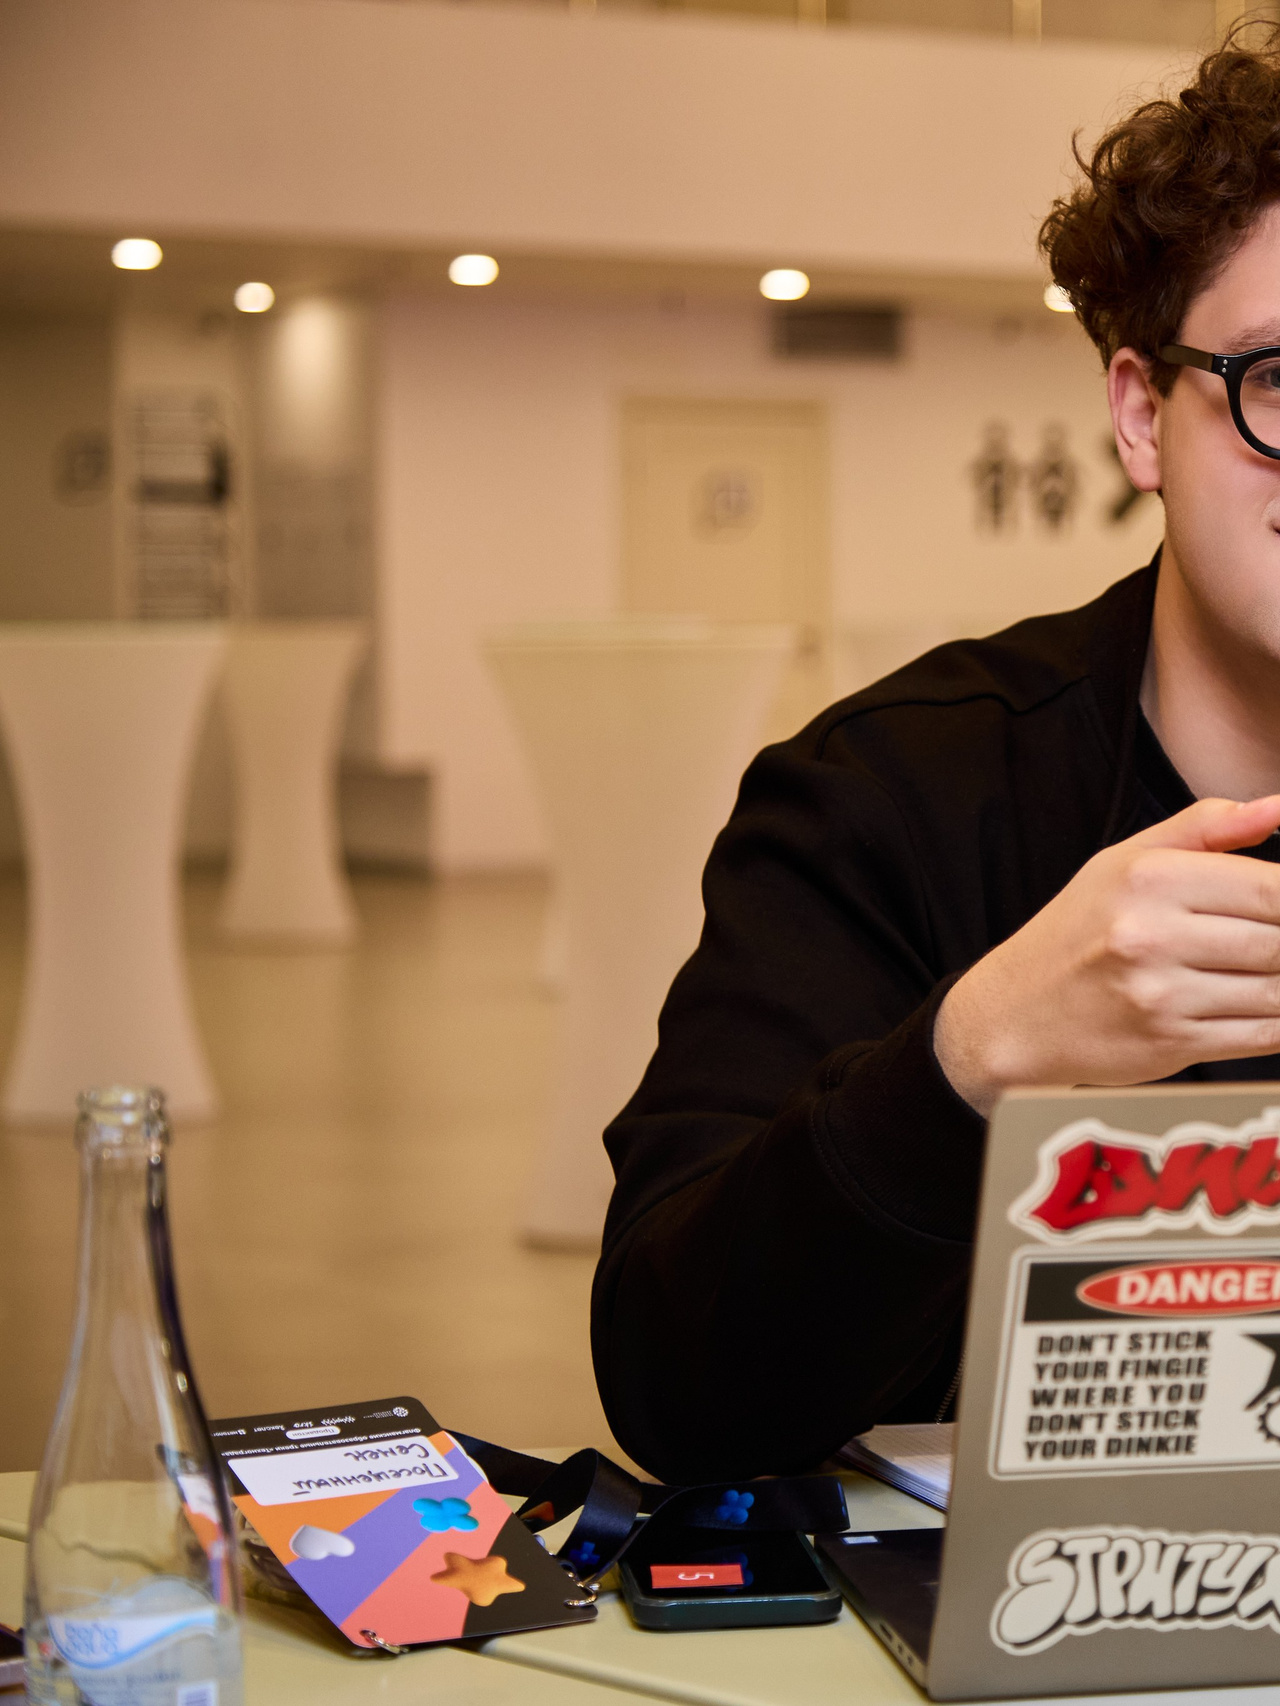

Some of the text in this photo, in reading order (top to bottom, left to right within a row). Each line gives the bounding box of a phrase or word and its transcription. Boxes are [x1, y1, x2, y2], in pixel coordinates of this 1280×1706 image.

[1037, 1329, 1213, 1357] DON'T STICK
[1035, 1356, 1210, 1382] YOUR FINGIE
[1030, 1382, 1208, 1409] WHERE YOU
[1027, 1409, 1201, 1435] DON'T STICK
[343, 1443, 430, 1462] Семен
[1025, 1434, 1198, 1461] YOUR DINKIE
